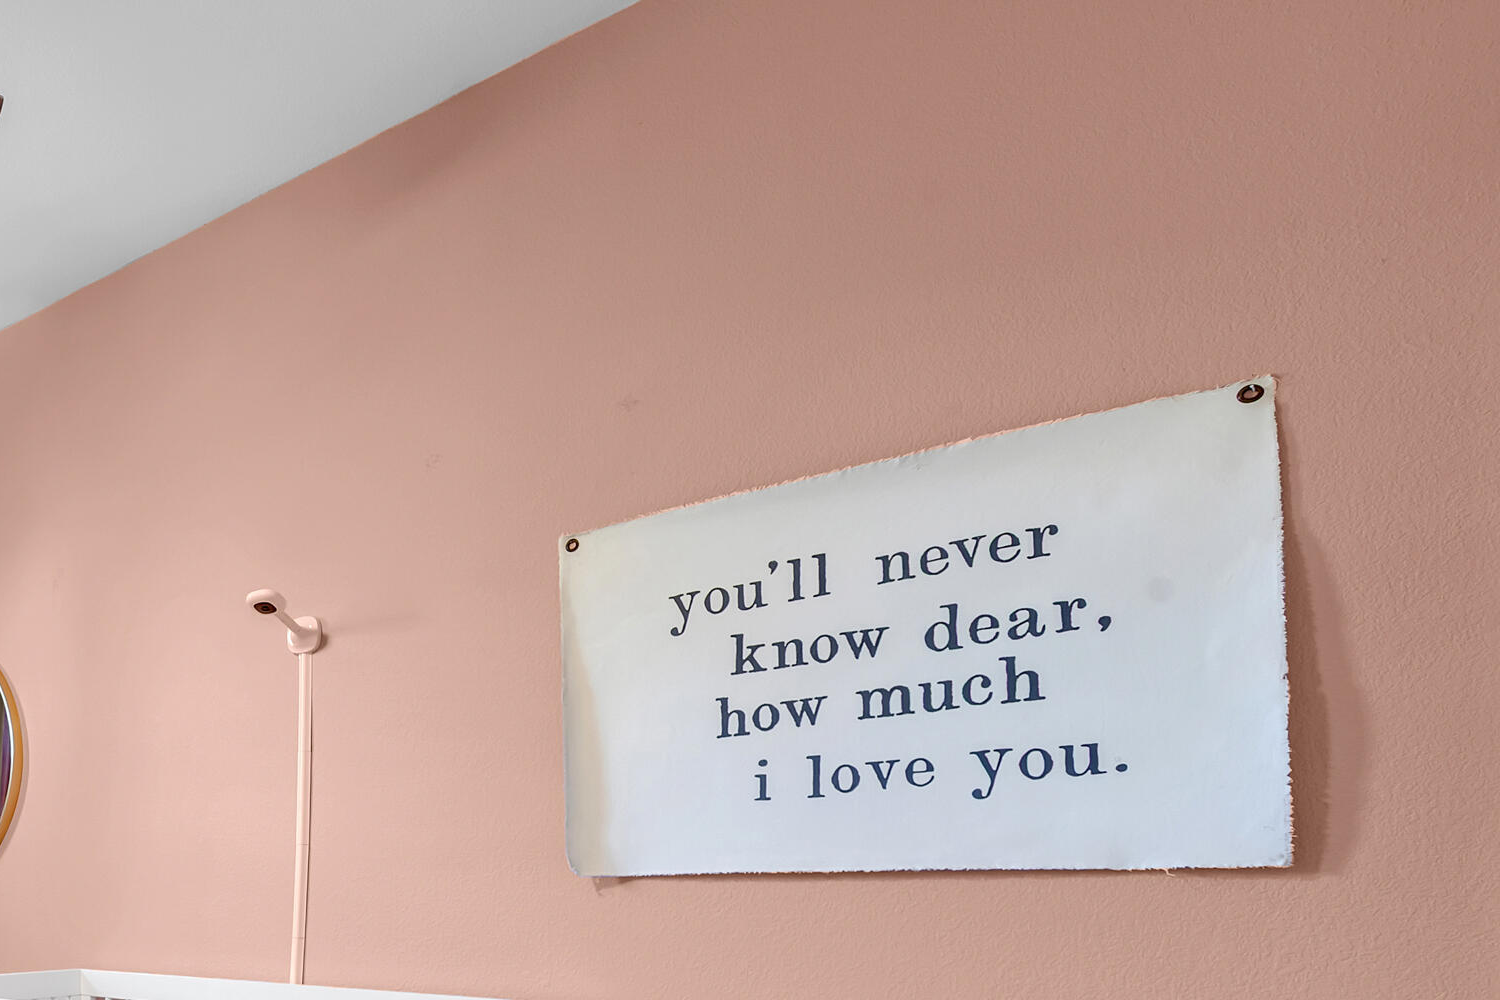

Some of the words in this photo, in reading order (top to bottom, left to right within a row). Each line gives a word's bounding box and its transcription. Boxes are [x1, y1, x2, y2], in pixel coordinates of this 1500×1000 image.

[874, 524, 1059, 586] never
[730, 626, 890, 676] know
[924, 597, 1112, 653] dear,
[715, 695, 829, 739] how
[855, 655, 1047, 721] much
[754, 759, 772, 801] i
[805, 754, 935, 799] love
[969, 742, 1128, 800] you.
